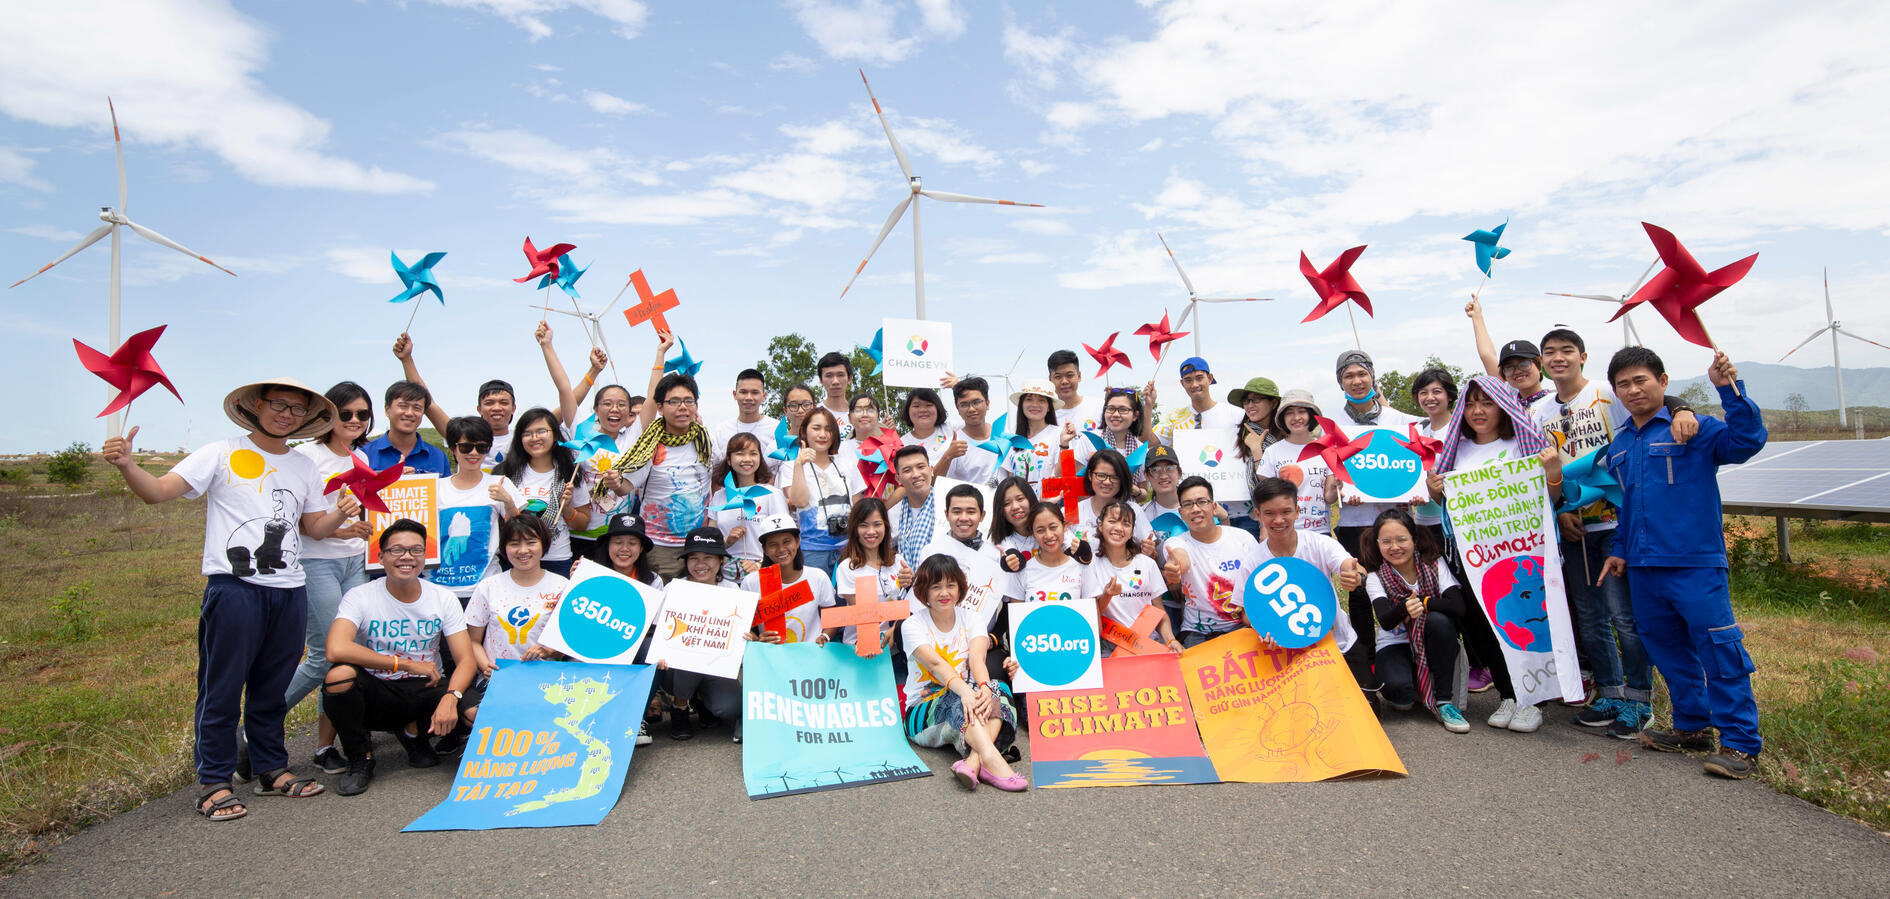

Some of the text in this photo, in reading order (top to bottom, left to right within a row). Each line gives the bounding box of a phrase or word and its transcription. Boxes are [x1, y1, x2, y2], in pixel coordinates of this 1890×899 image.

[1585, 434, 1611, 449] NAM
[1448, 466, 1502, 489] TRUNG
[377, 486, 428, 500] CLIMATE
[385, 497, 428, 512] USTICE
[436, 574, 478, 584] CLIMATE
[437, 565, 477, 575] RISE FOR
[368, 618, 442, 638] RISE FOR
[703, 639, 726, 650] NAM
[1197, 650, 1260, 691] BẮT
[789, 678, 848, 699] 100%
[747, 691, 898, 730] RENEWABLES
[1037, 686, 1182, 717] RISE FOR
[1040, 706, 1187, 738] CLIMATE
[476, 726, 561, 757] 100%
[796, 731, 854, 744] FOR ALL
[463, 752, 577, 779] NĂNG LƯỢNG
[453, 780, 538, 802] TÁI TẠO
